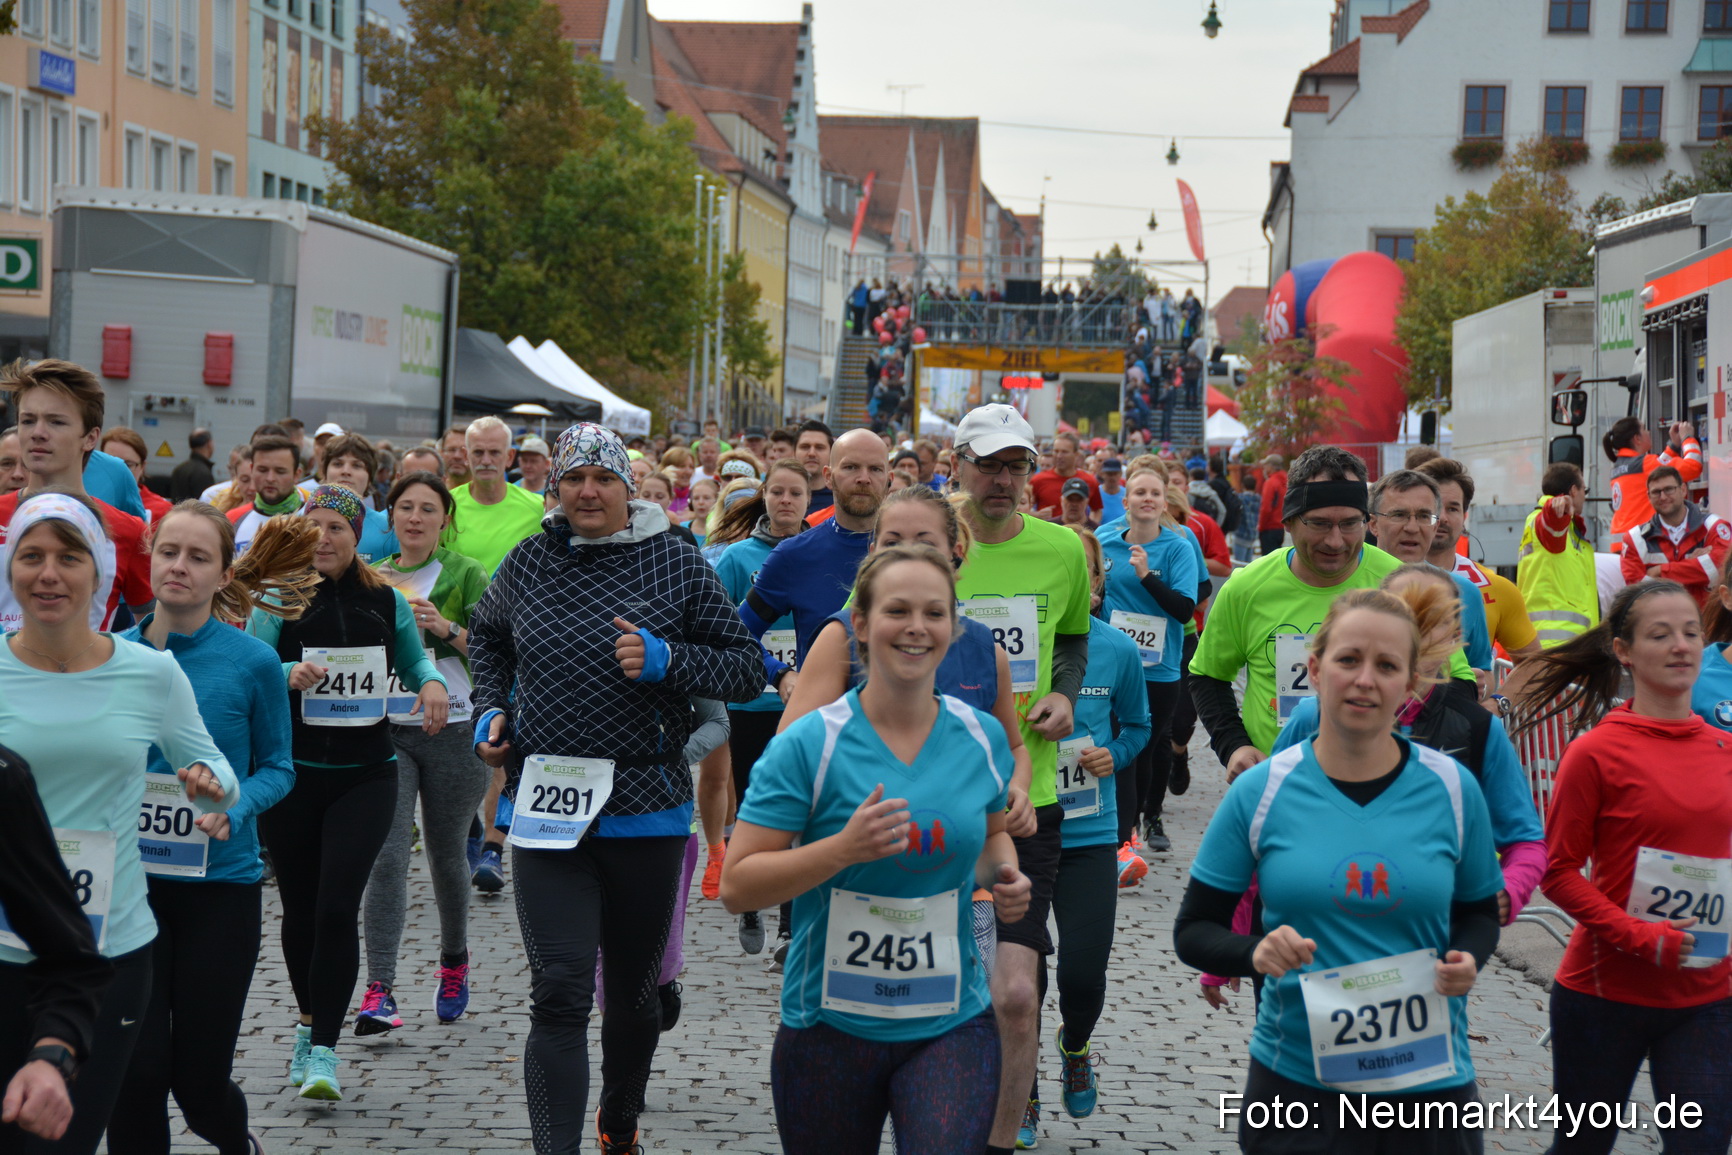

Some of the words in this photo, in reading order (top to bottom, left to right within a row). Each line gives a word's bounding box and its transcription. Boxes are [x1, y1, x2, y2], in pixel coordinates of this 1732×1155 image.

[1601, 291, 1634, 349] BOCK
[401, 306, 442, 375] BOCK
[1001, 350, 1046, 369] ZIEL
[975, 607, 1009, 616] BOCK
[315, 671, 374, 695] 2414
[1078, 687, 1109, 696] OCK
[330, 703, 360, 713] Andrea
[552, 765, 586, 775] BOCK
[1057, 763, 1086, 789] 14
[530, 784, 593, 815] 2291
[539, 823, 576, 834] Andreas
[1684, 866, 1717, 878] BOCK
[71, 869, 93, 906] 8
[1646, 886, 1725, 925] 2240
[846, 930, 935, 972] 2451
[1355, 969, 1401, 987] BOCK
[874, 983, 911, 997] Steffi
[1331, 994, 1428, 1045] 2370
[1357, 1051, 1415, 1071] Kathrina
